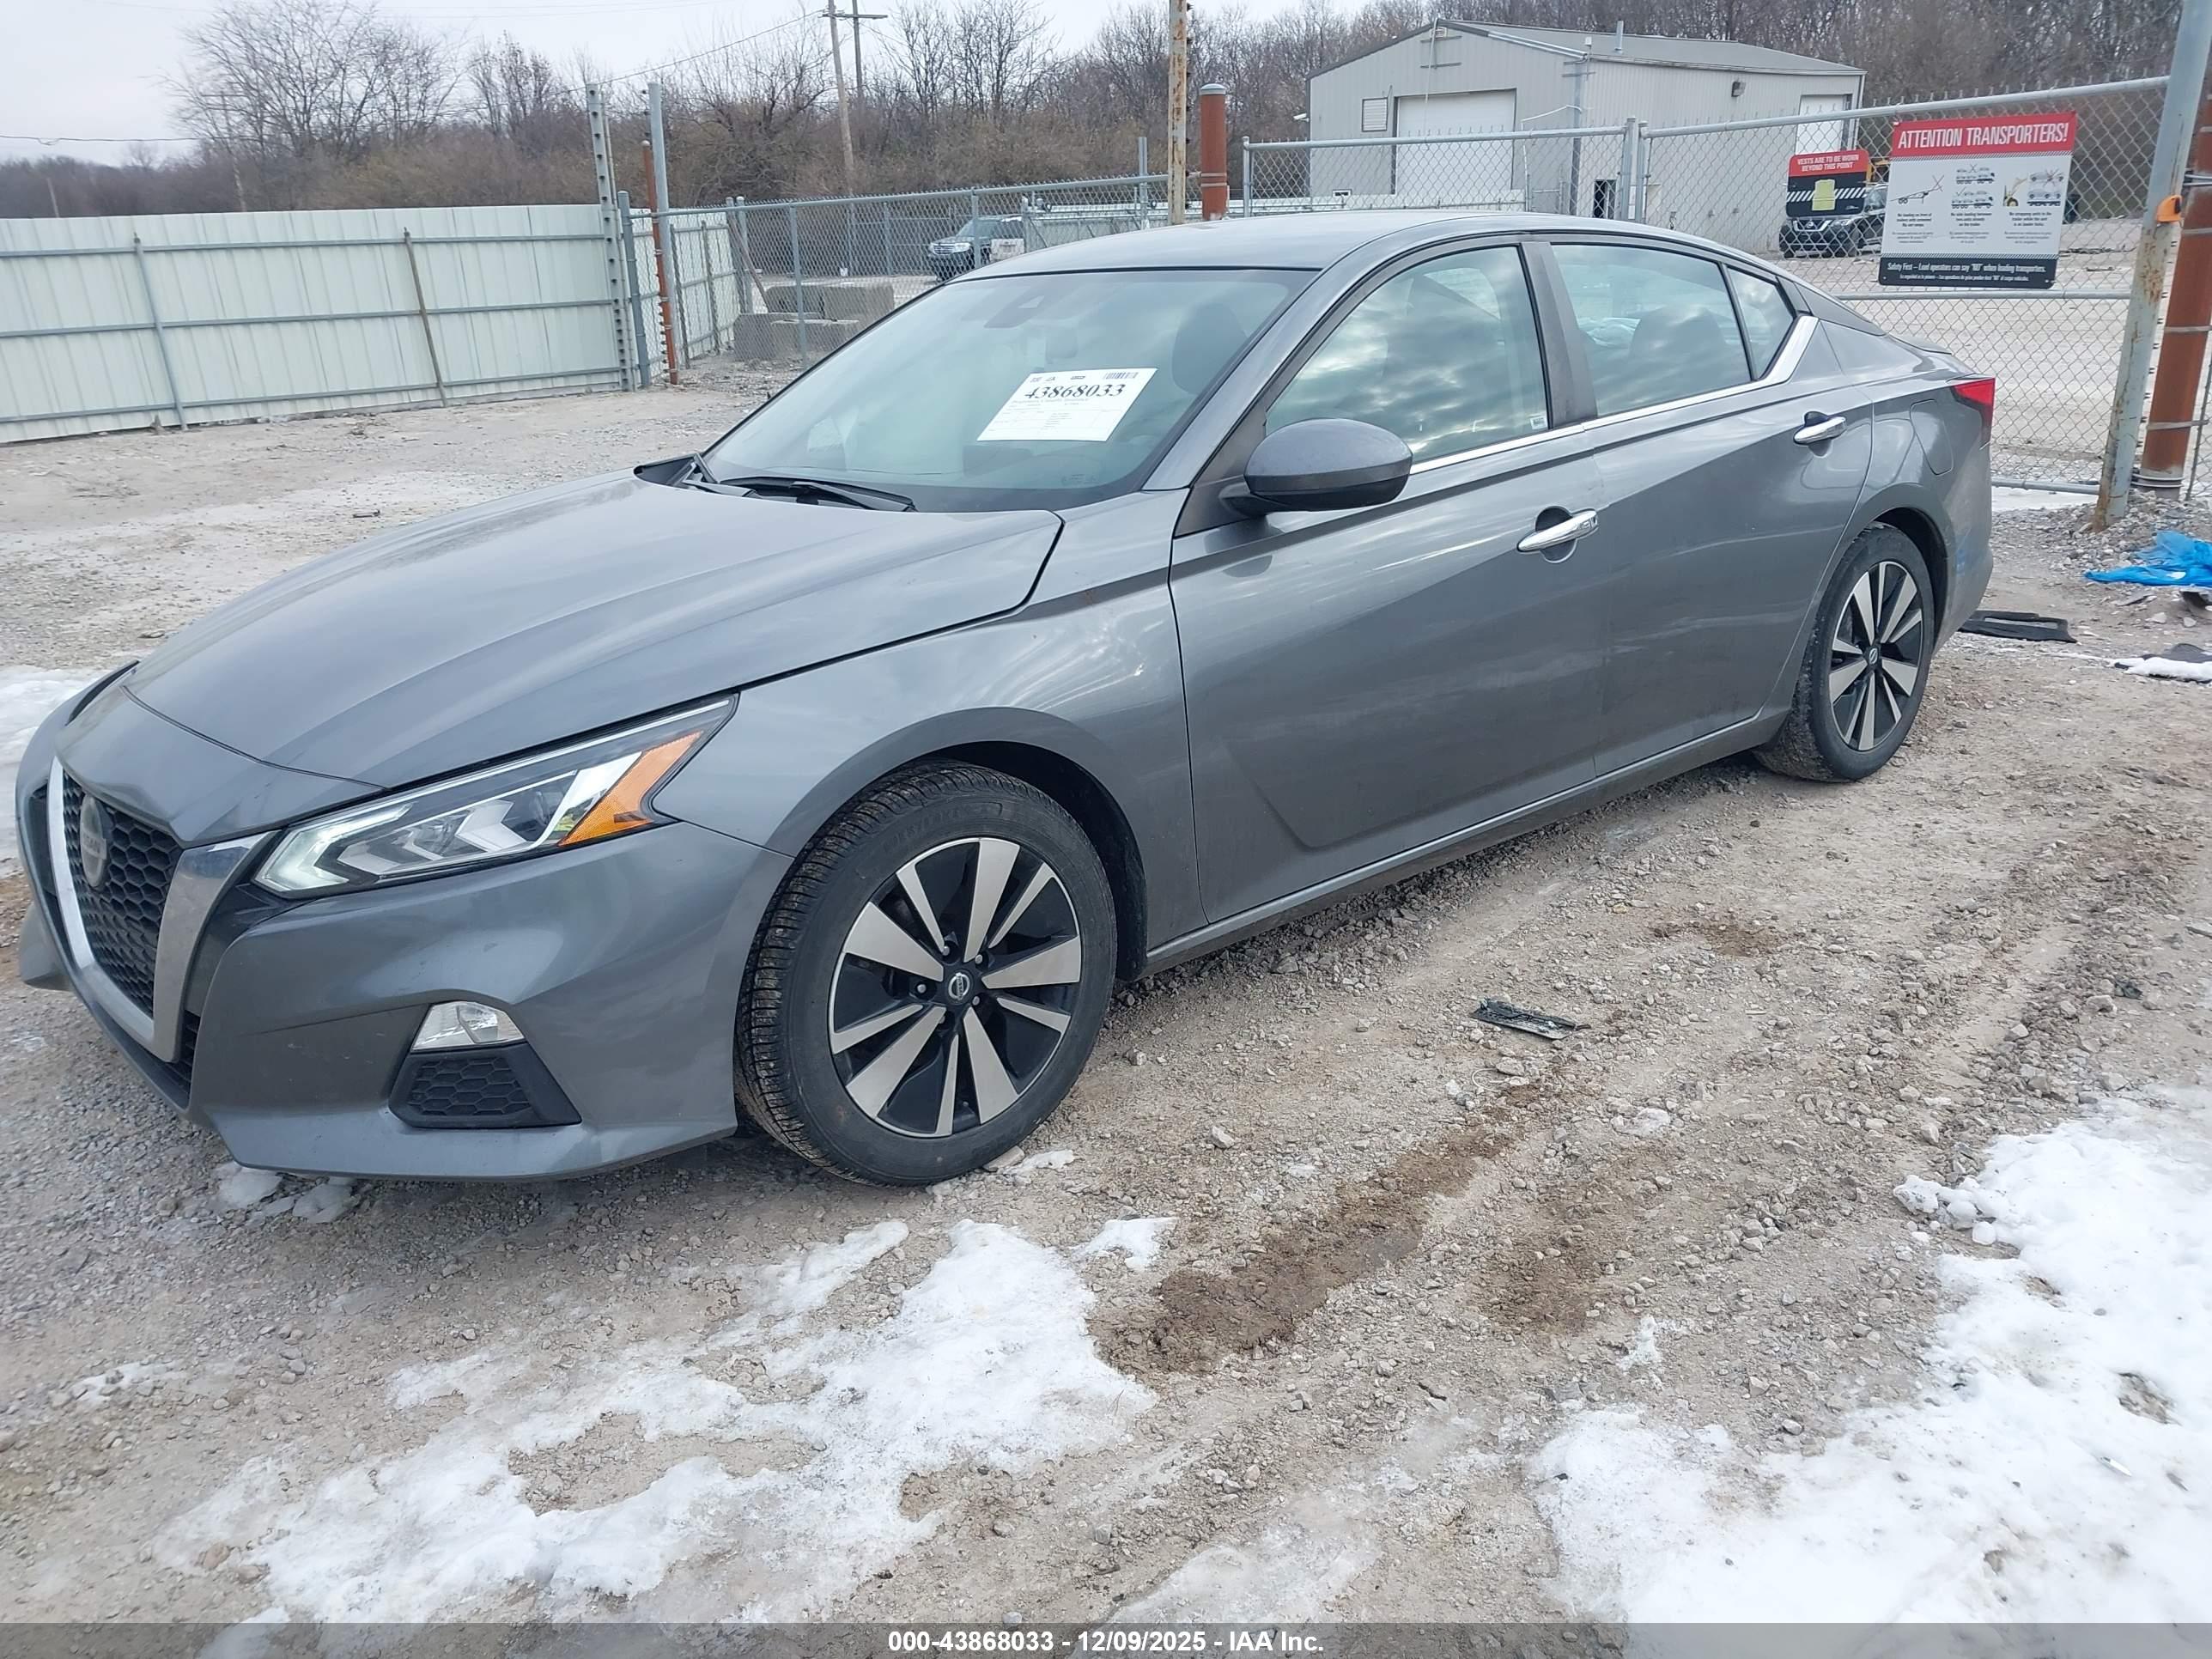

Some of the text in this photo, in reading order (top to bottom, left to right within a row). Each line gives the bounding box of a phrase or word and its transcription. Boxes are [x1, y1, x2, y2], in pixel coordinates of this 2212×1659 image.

[1898, 123, 2069, 149] ATTENTION TRANSPORTERS!
[1024, 384, 1126, 398] 43868033
